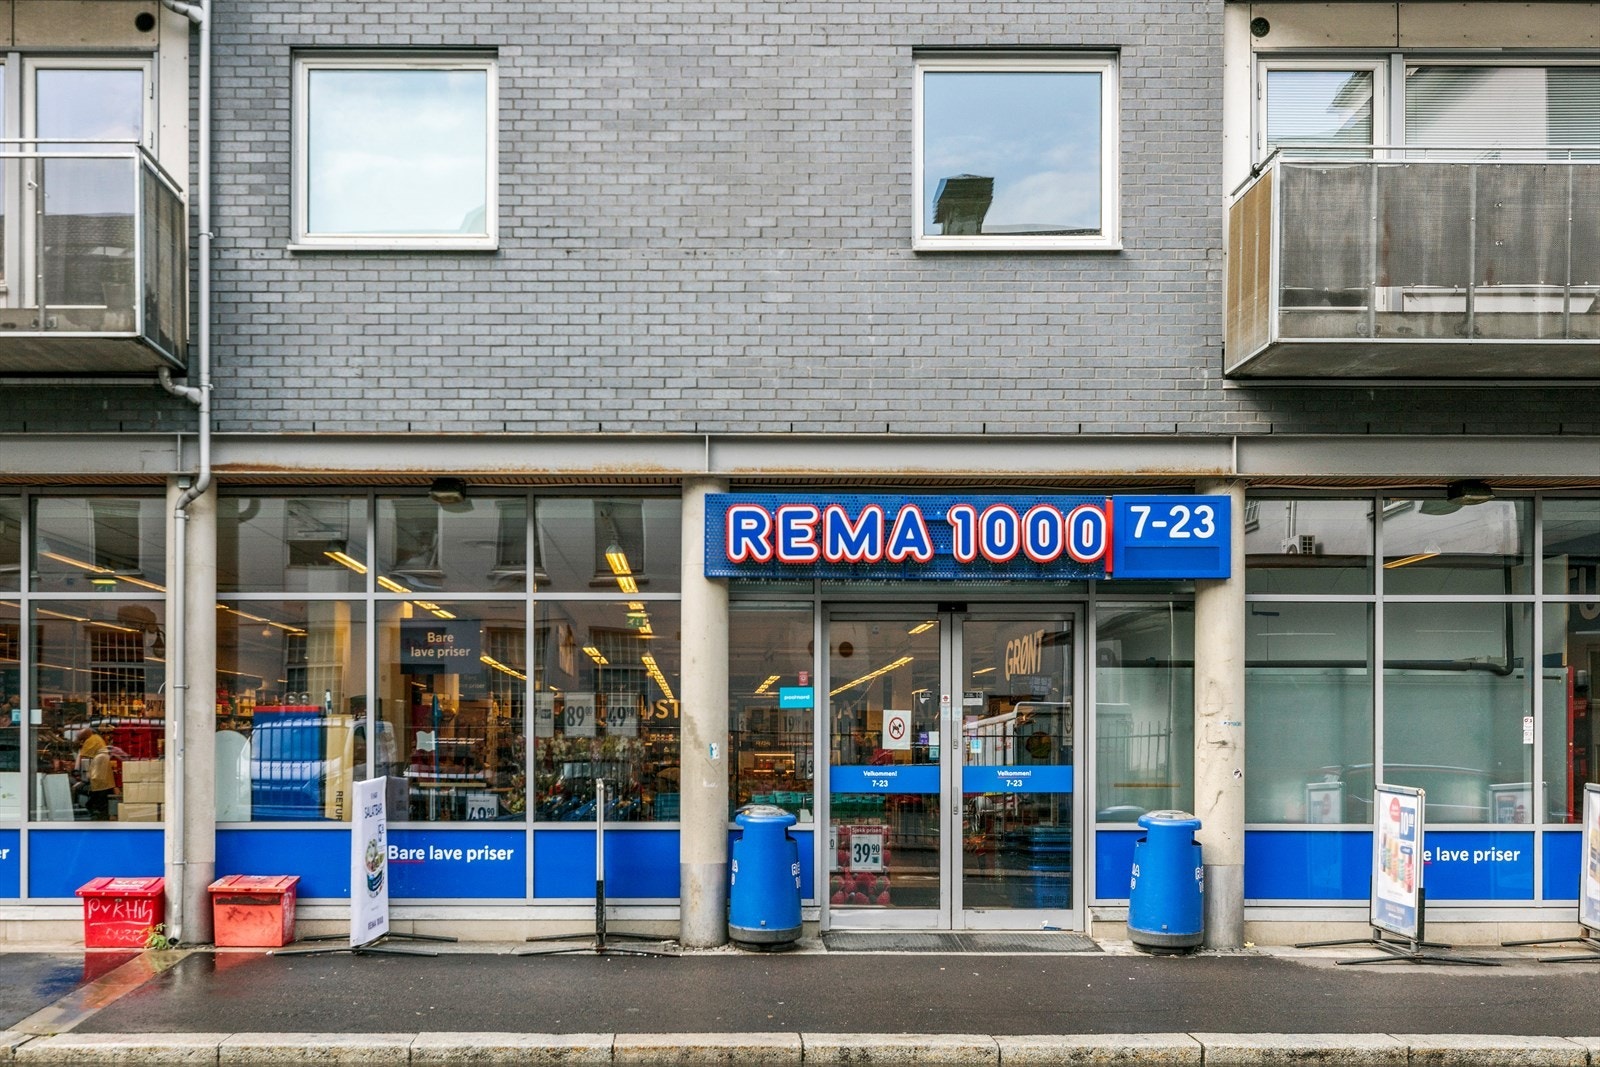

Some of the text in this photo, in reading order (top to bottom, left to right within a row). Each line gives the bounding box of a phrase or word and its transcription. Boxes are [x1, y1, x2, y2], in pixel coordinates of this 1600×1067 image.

[1129, 505, 1215, 539] 7-23
[726, 503, 1107, 564] REMA 1000
[427, 632, 454, 643] Bare
[411, 646, 471, 659] lave priser
[1005, 629, 1046, 682] GRØNT
[567, 705, 585, 727] 89
[607, 706, 626, 727] 49
[388, 845, 514, 863] Bare lave priser
[853, 843, 880, 863] 39 90
[1436, 847, 1469, 861] lave
[1473, 847, 1521, 864] priser
